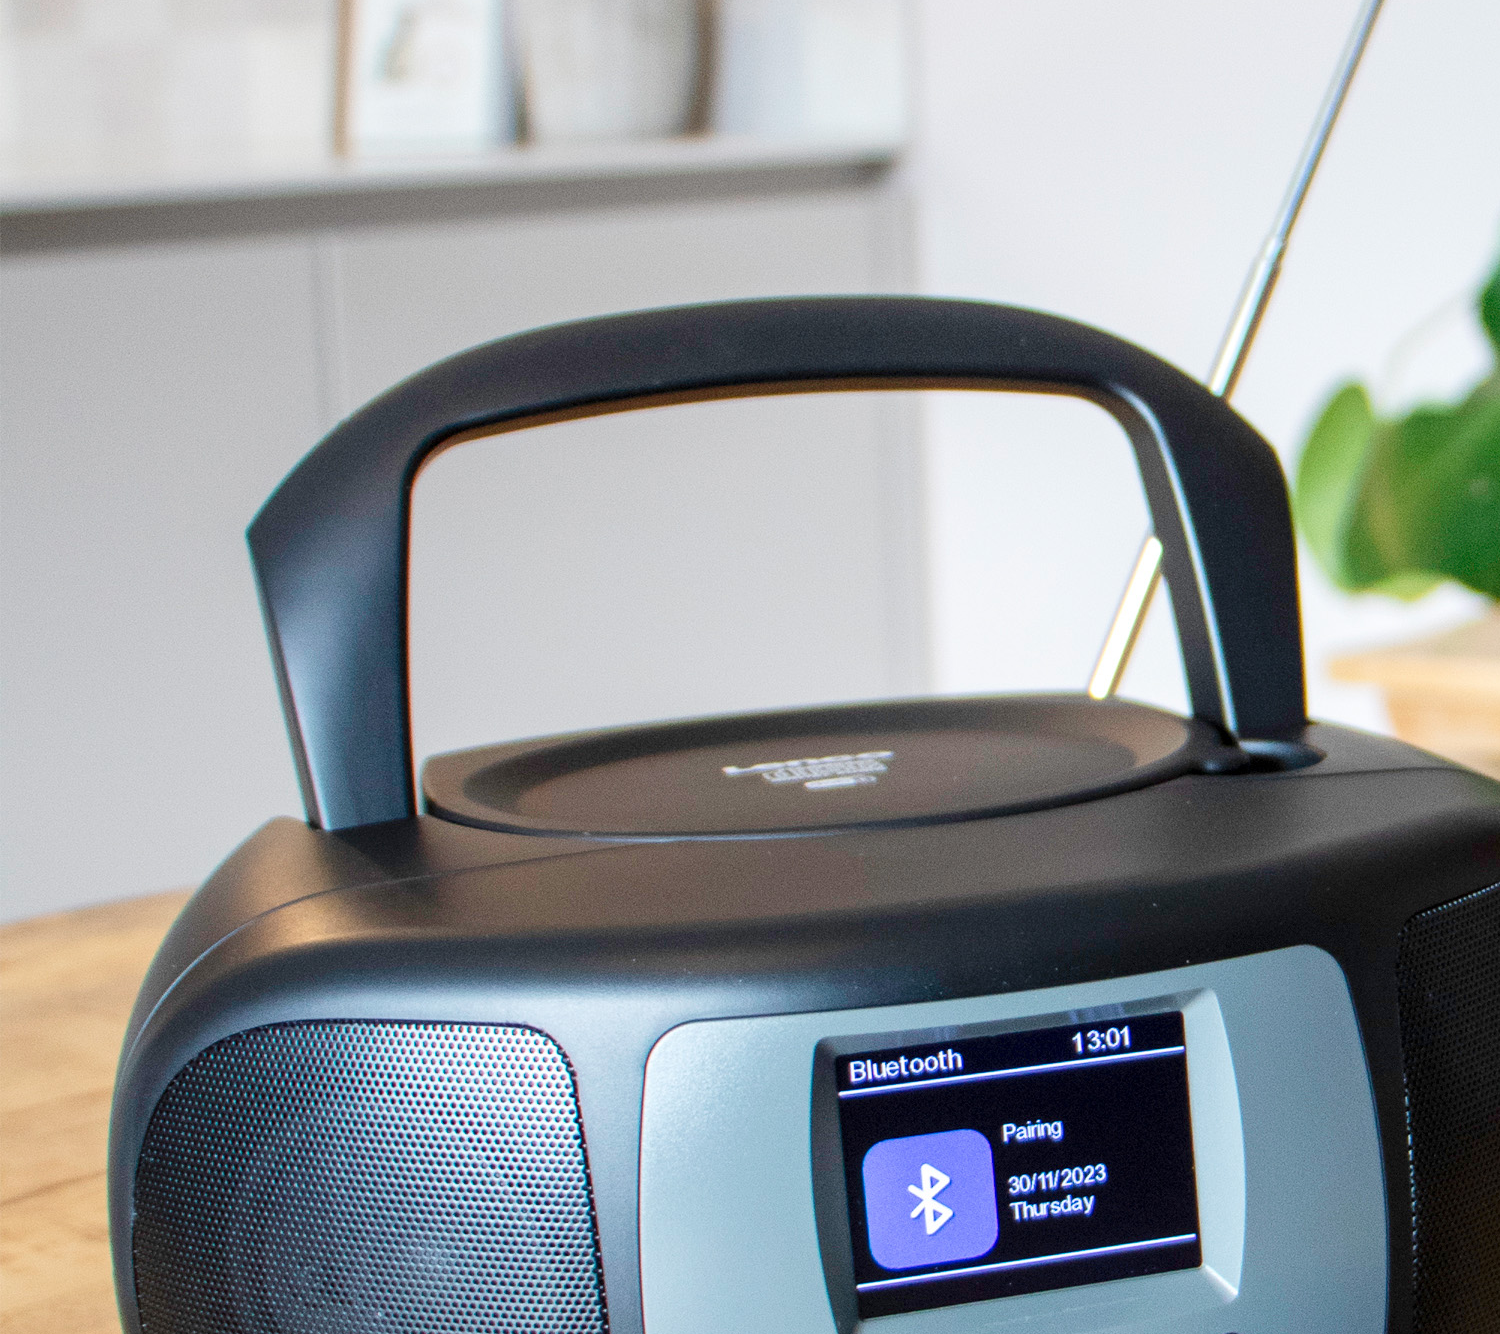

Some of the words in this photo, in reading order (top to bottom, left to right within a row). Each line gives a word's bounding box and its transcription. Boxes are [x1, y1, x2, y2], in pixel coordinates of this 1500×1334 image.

[1071, 1025, 1132, 1054] 13:01
[849, 1048, 963, 1084] Bluetooth
[1002, 1118, 1064, 1143] Pairing
[1007, 1163, 1107, 1194] 30/11/2023
[1009, 1193, 1095, 1220] Thursday
